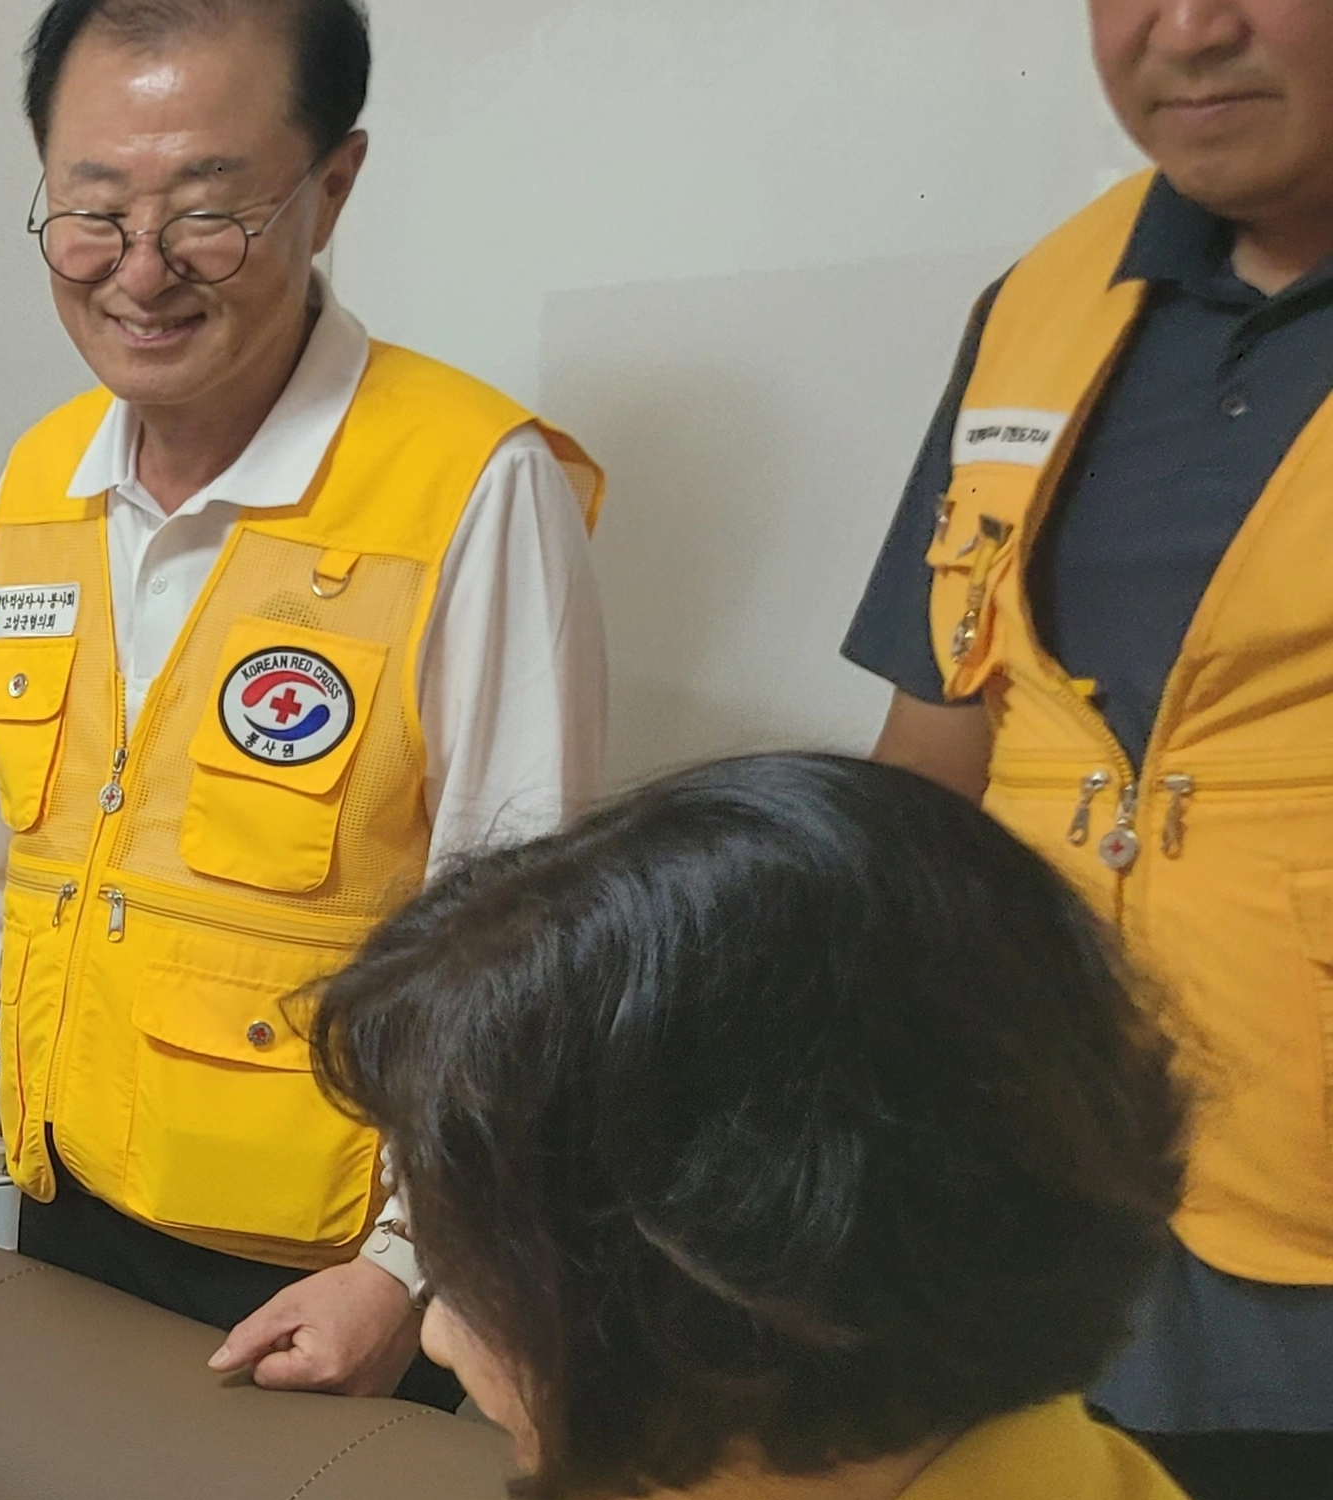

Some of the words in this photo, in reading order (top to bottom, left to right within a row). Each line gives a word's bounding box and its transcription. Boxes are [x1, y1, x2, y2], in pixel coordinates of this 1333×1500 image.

[241, 655, 288, 681] KOREAN
[290, 655, 313, 673] RED
[313, 665, 343, 700] CROSS
[244, 731, 295, 758] 봉사원
